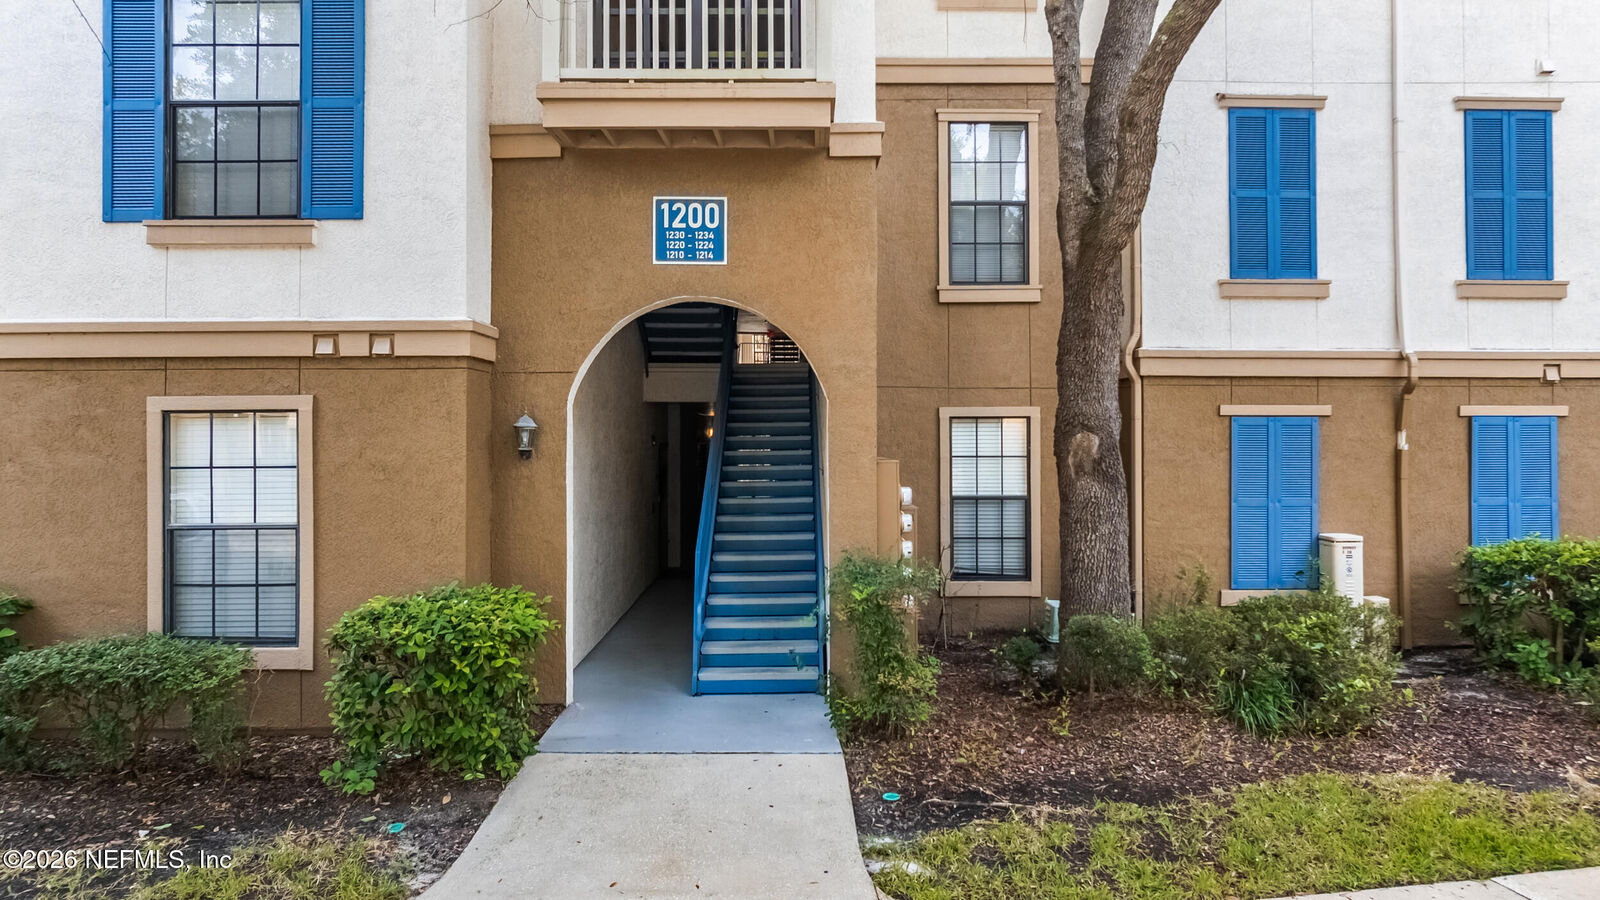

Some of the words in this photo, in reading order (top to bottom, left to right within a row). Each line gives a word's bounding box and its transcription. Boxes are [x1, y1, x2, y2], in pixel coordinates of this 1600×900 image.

[661, 203, 719, 228] 1200
[666, 231, 685, 239] 1230
[695, 231, 714, 239] 1234
[666, 241, 685, 249] 1220
[695, 241, 714, 249] 1224
[666, 251, 685, 259] 1210
[696, 251, 714, 259] 1214
